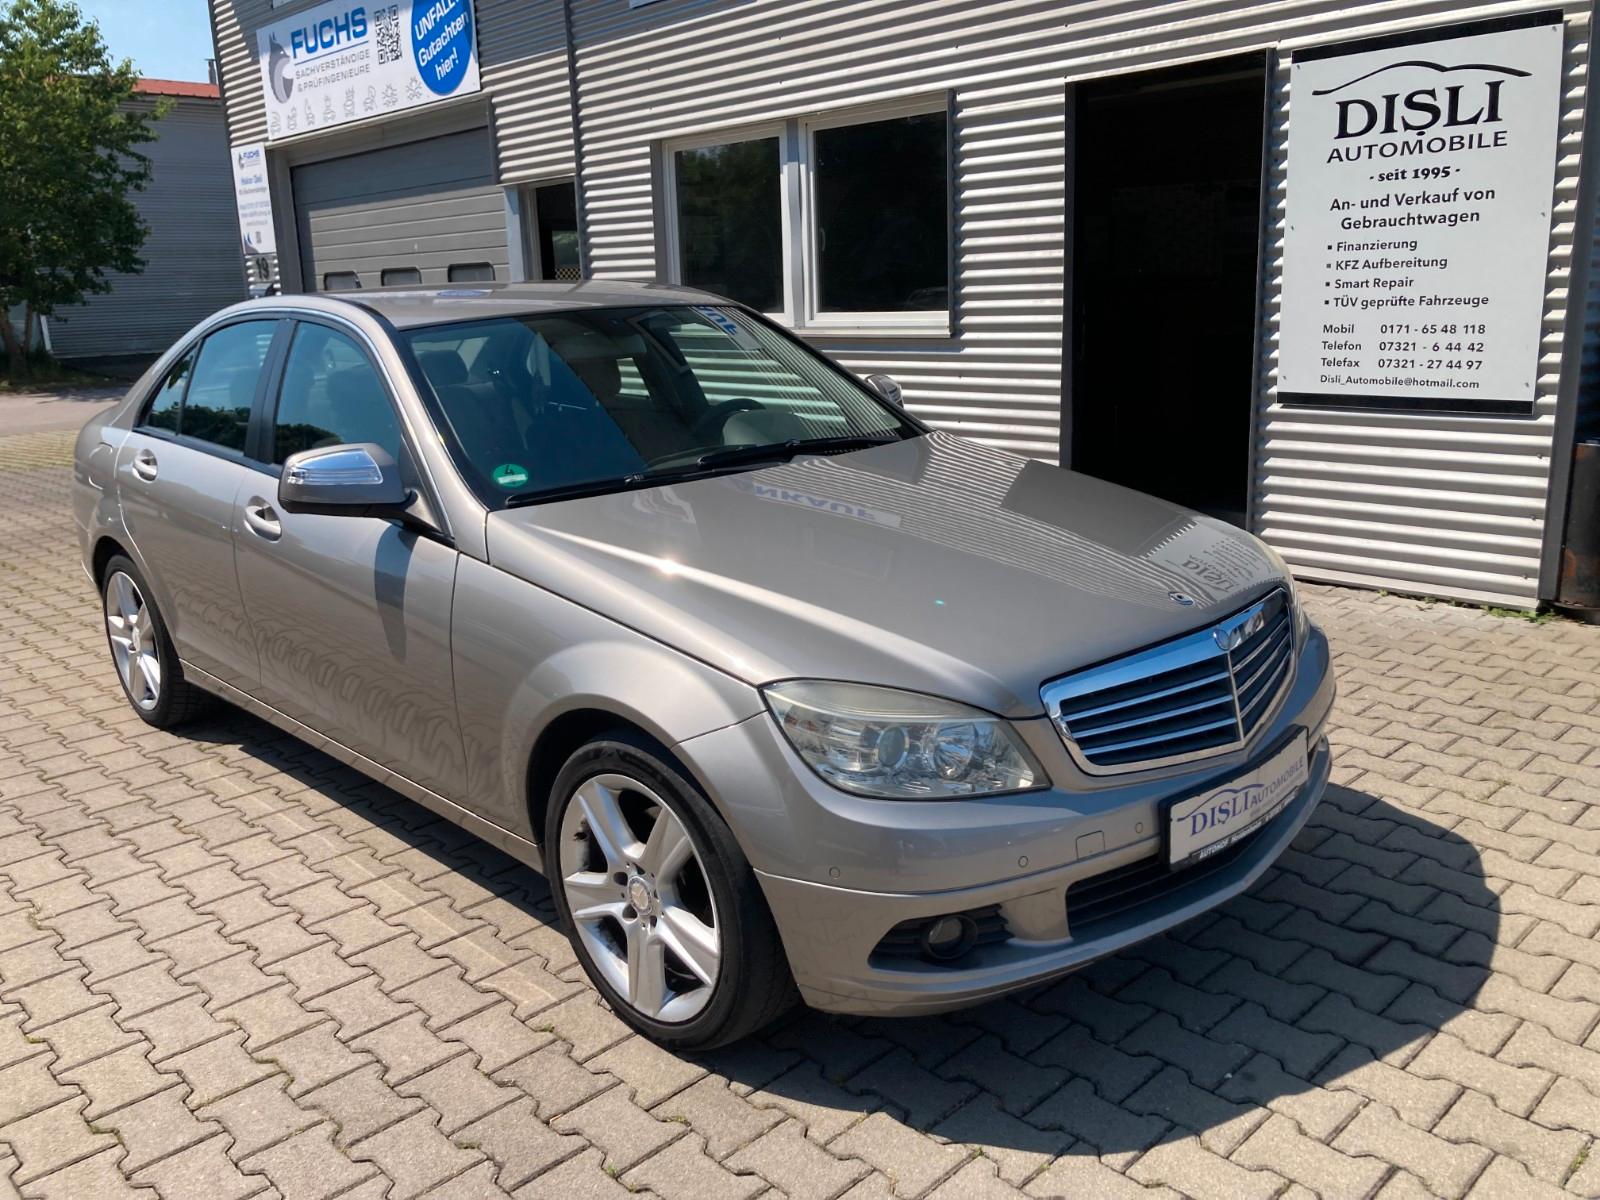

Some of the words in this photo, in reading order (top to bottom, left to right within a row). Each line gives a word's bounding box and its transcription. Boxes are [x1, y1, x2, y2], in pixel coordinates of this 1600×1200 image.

[290, 6, 368, 59] FUCHS
[417, 11, 470, 68] Gutachten
[295, 48, 371, 80] SACHVERSTÄNDIGE
[434, 46, 460, 81] hier!
[1326, 130, 1508, 164] AUTOMOBILE
[1377, 168, 1408, 182] seit
[1411, 166, 1451, 181] 1995
[1329, 199, 1356, 212] An-
[1360, 194, 1390, 209] und
[1394, 188, 1460, 207] Verkauf
[1463, 189, 1496, 201] von
[1340, 212, 1480, 230] Gebrauchtwagen
[1336, 240, 1418, 253] Finanzierung
[1335, 260, 1360, 271] KFZ
[1361, 257, 1448, 270] Aufbereitung
[1334, 278, 1370, 289] Smart
[1372, 277, 1415, 291] Repair
[1333, 294, 1359, 308] TÜV
[1360, 297, 1415, 310] geprüfte
[1418, 295, 1489, 308] Fahrzeuge
[1322, 323, 1355, 334] Mobil
[1380, 324, 1410, 335] 0171
[1421, 324, 1437, 335] 65
[1440, 324, 1457, 335] 48
[1463, 324, 1486, 335] 118
[1321, 341, 1362, 351] Telefon
[1378, 341, 1417, 352] 07321
[1432, 342, 1440, 352] 6
[1444, 342, 1462, 352] 44
[1467, 342, 1484, 353] 42
[1320, 357, 1360, 368] Telefax
[1377, 358, 1415, 369] 07321
[1426, 359, 1443, 370] 27
[1445, 360, 1463, 370] 44
[1465, 360, 1483, 370] 97
[1320, 374, 1480, 389] Disli_Automobile@hotmail.com
[1250, 755, 1304, 809] AUTOMOBILE
